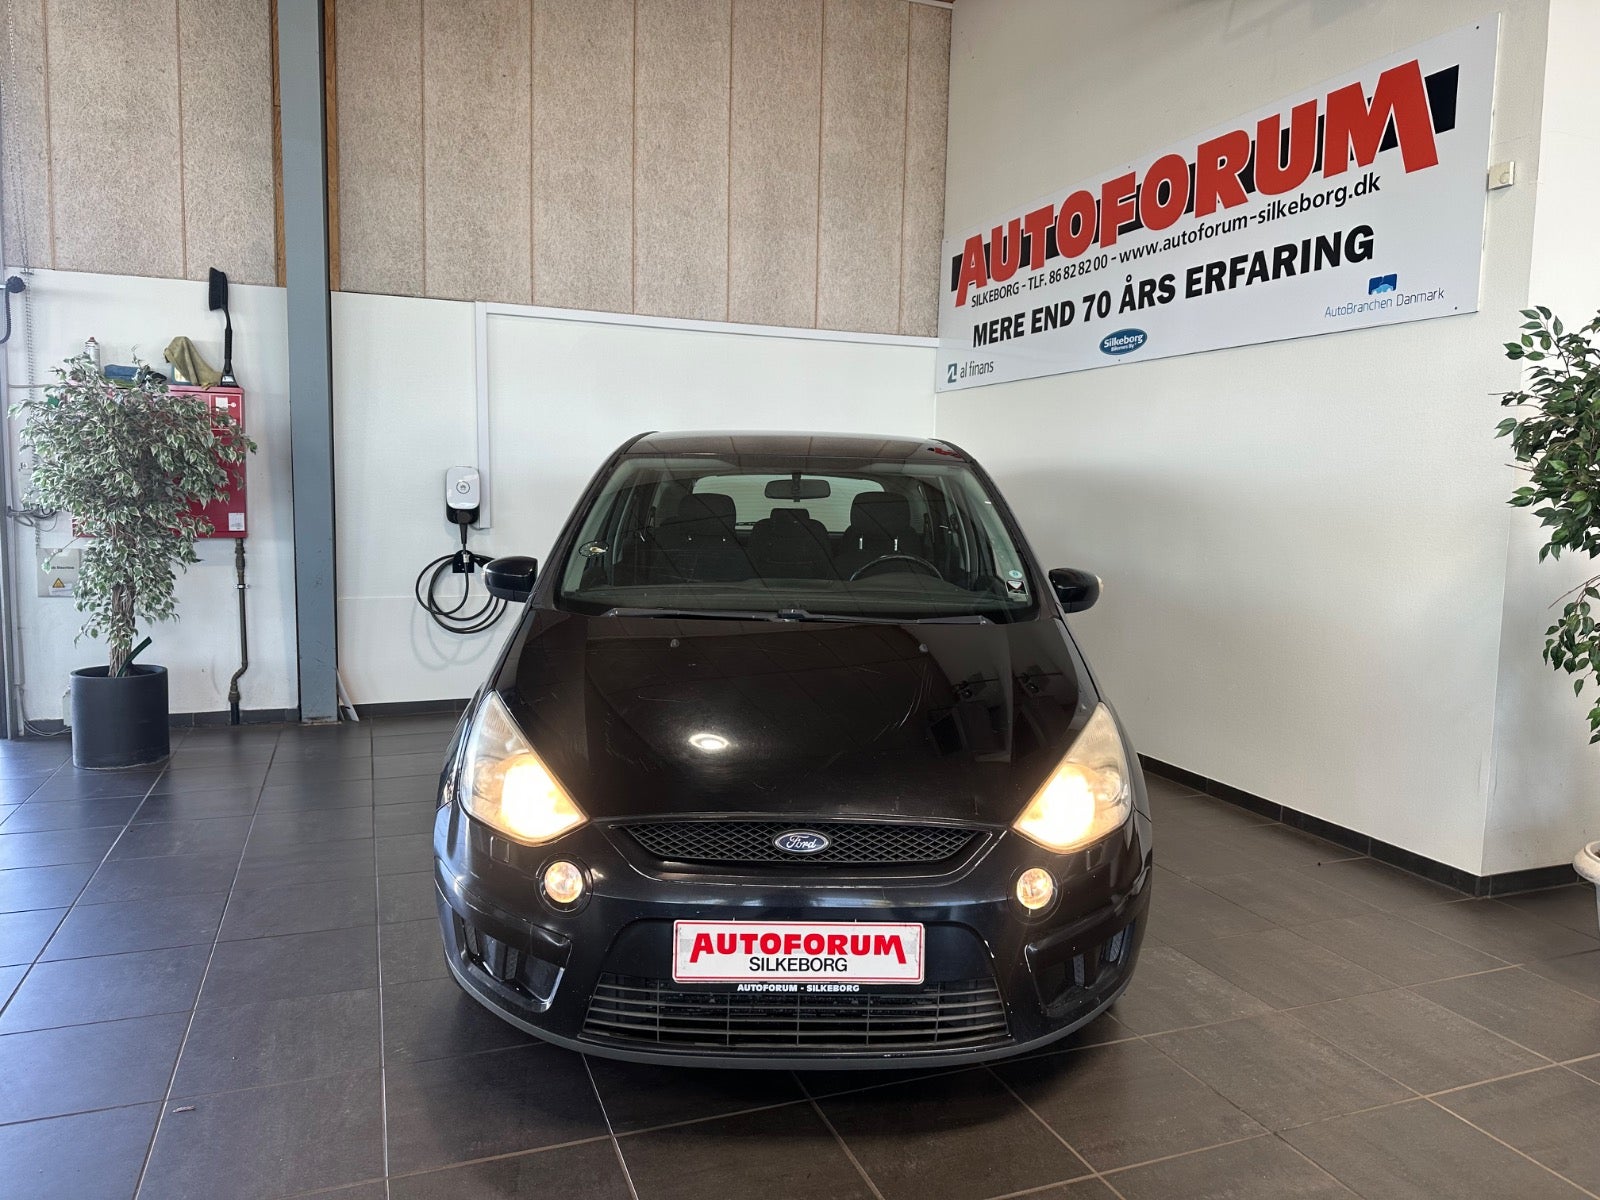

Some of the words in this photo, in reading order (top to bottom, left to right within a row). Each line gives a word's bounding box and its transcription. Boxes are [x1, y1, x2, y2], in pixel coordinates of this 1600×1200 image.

[954, 59, 1439, 307] AUTOFORUM
[971, 281, 1020, 308] SILKEBORG
[1028, 275, 1047, 291] TLF.
[1119, 172, 1381, 264] www.autoforum-silkeborg.dk
[973, 312, 1025, 348] MERE
[1030, 300, 1075, 335] END
[1082, 290, 1111, 322] 70
[1118, 274, 1176, 314] ÅRS
[1185, 224, 1375, 299] ERFARING
[1325, 298, 1392, 318] AutoBranchen
[1396, 287, 1445, 307] Danmark
[1103, 334, 1143, 348] Silkeborg
[960, 362, 968, 378] al
[969, 361, 994, 377] finans
[786, 835, 817, 849] Ford
[689, 932, 907, 964] AUTOFORUM
[749, 957, 848, 972] SILKEBORG
[737, 984, 798, 992] AUTOFORUM
[806, 984, 860, 992] SILKEBORG
